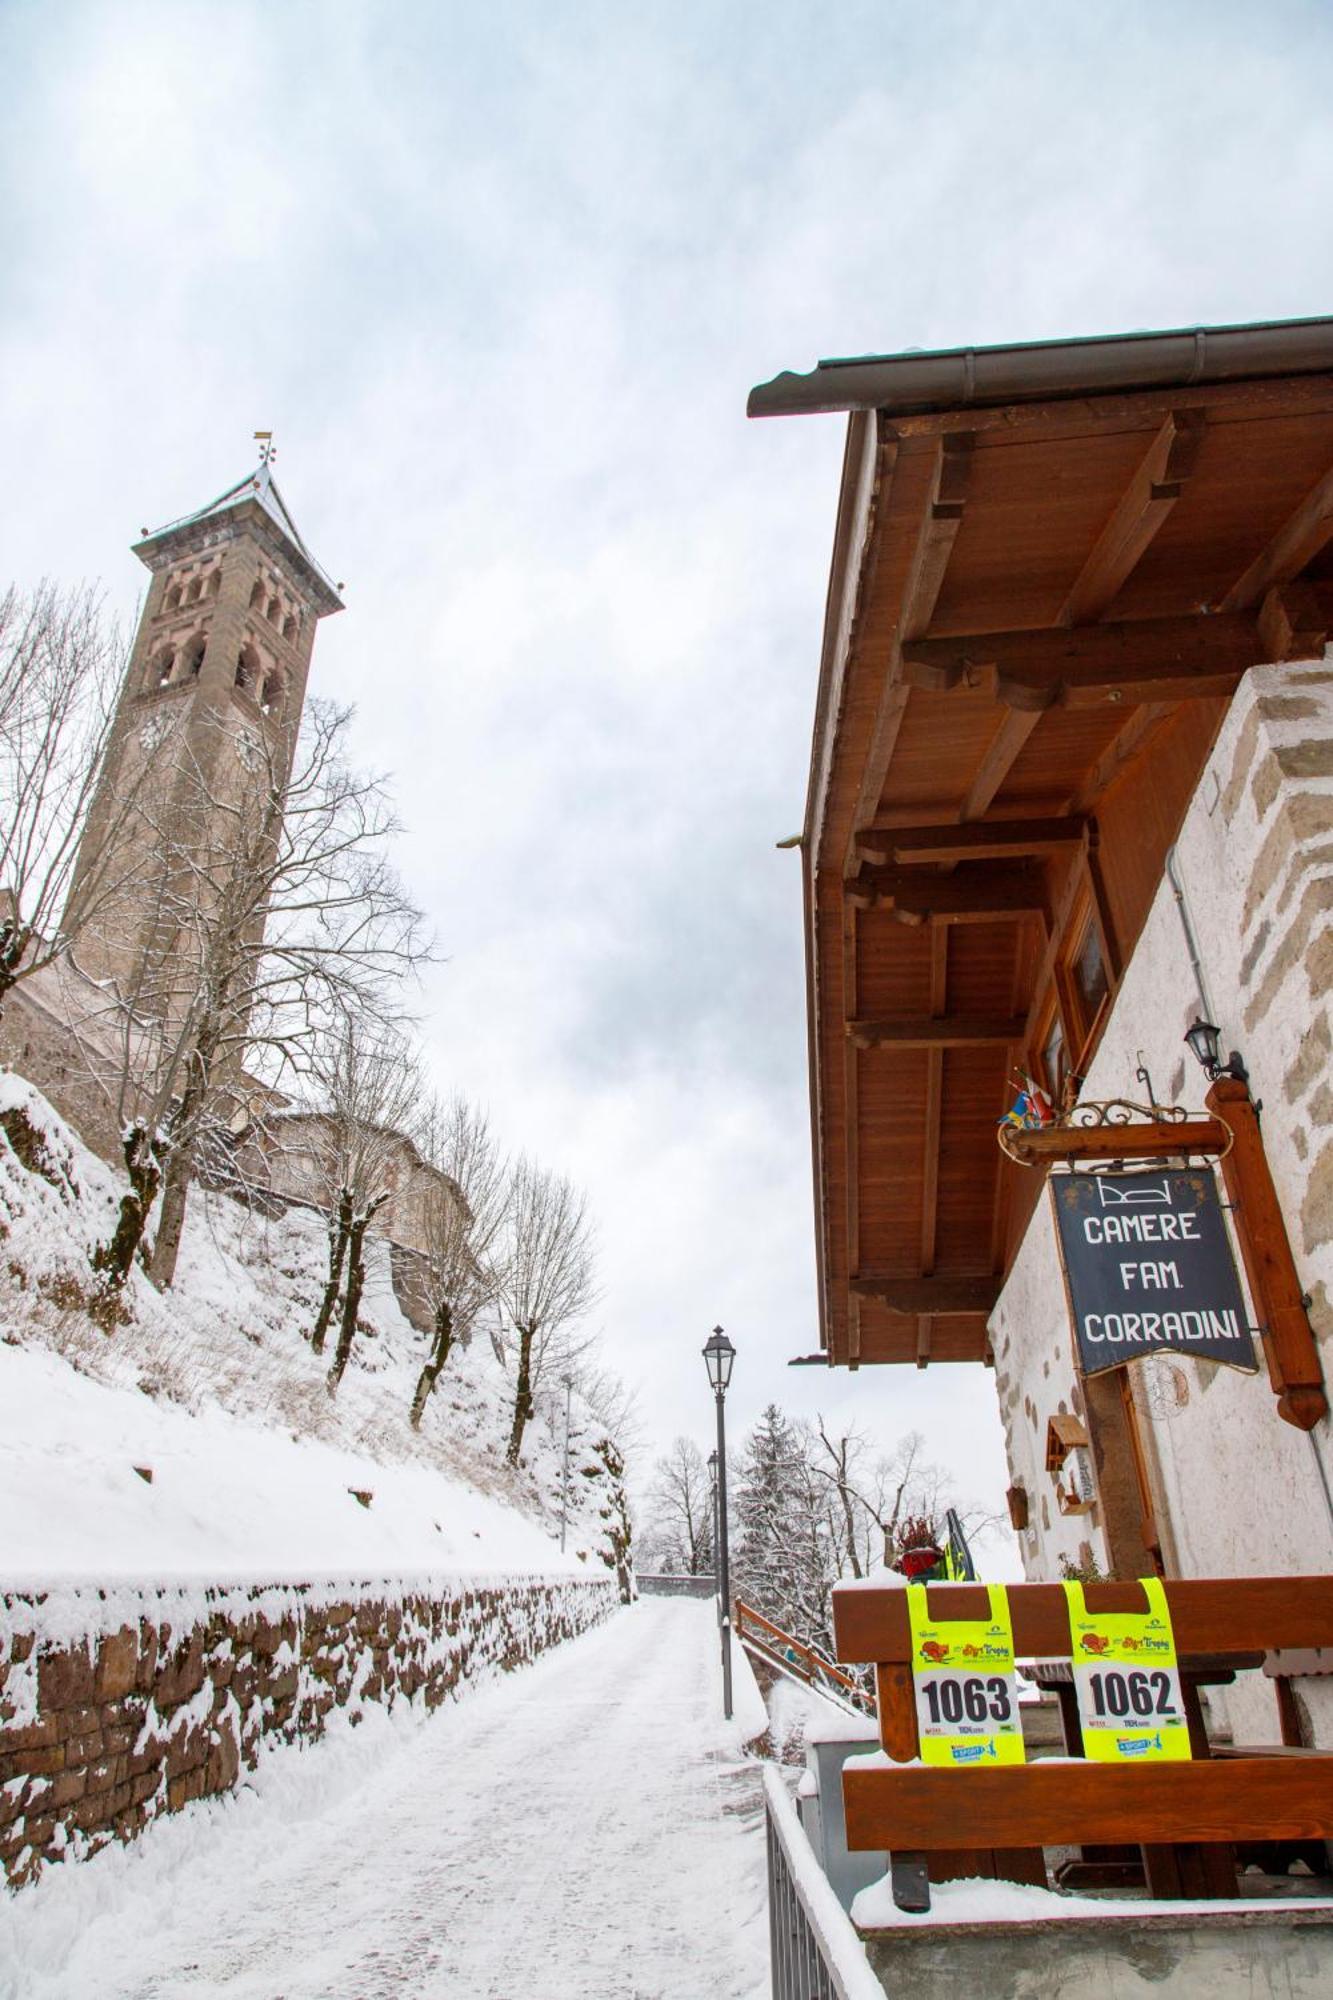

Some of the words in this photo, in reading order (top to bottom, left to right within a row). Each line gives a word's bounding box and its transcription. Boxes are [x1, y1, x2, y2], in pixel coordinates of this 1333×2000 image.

[1083, 1213, 1201, 1244] CAMERE
[1119, 1261, 1184, 1290] FAM.
[1084, 1310, 1240, 1342] CORRADINI
[922, 1678, 1011, 1723] 1063
[1089, 1672, 1176, 1716] 1062
